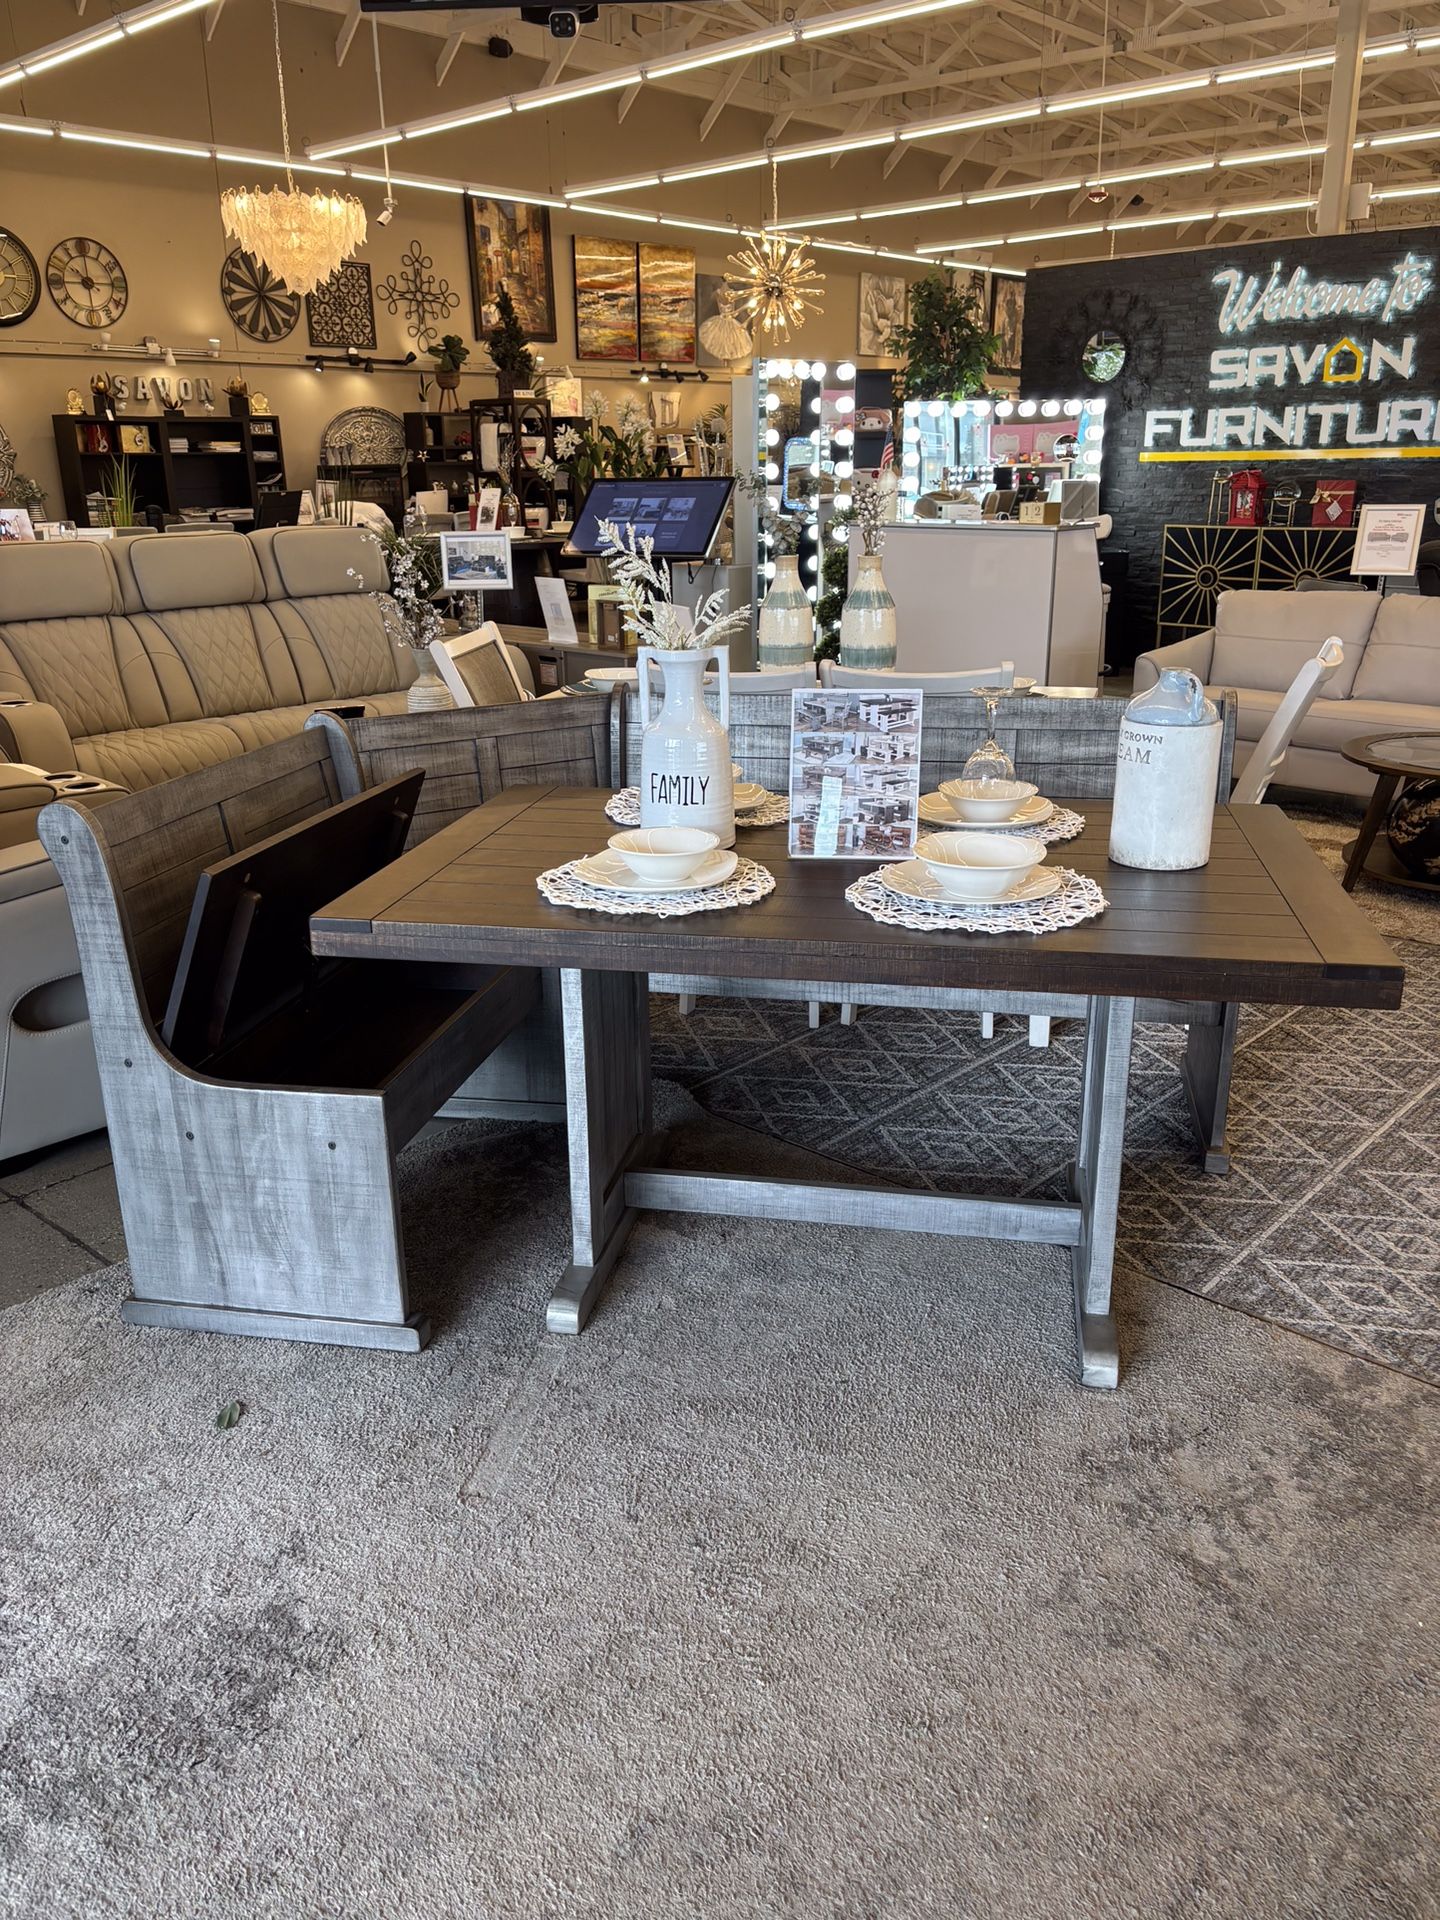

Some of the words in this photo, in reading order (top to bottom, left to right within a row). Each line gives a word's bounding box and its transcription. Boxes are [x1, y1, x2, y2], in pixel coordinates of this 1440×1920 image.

[1211, 261, 1388, 334] Welcome
[1382, 251, 1432, 322] to
[1208, 337, 1416, 389] SAVON
[114, 375, 216, 402] SAVON
[1143, 401, 1440, 448] FURNITUR
[1124, 730, 1163, 744] GROWN
[650, 772, 710, 806] FAMILY
